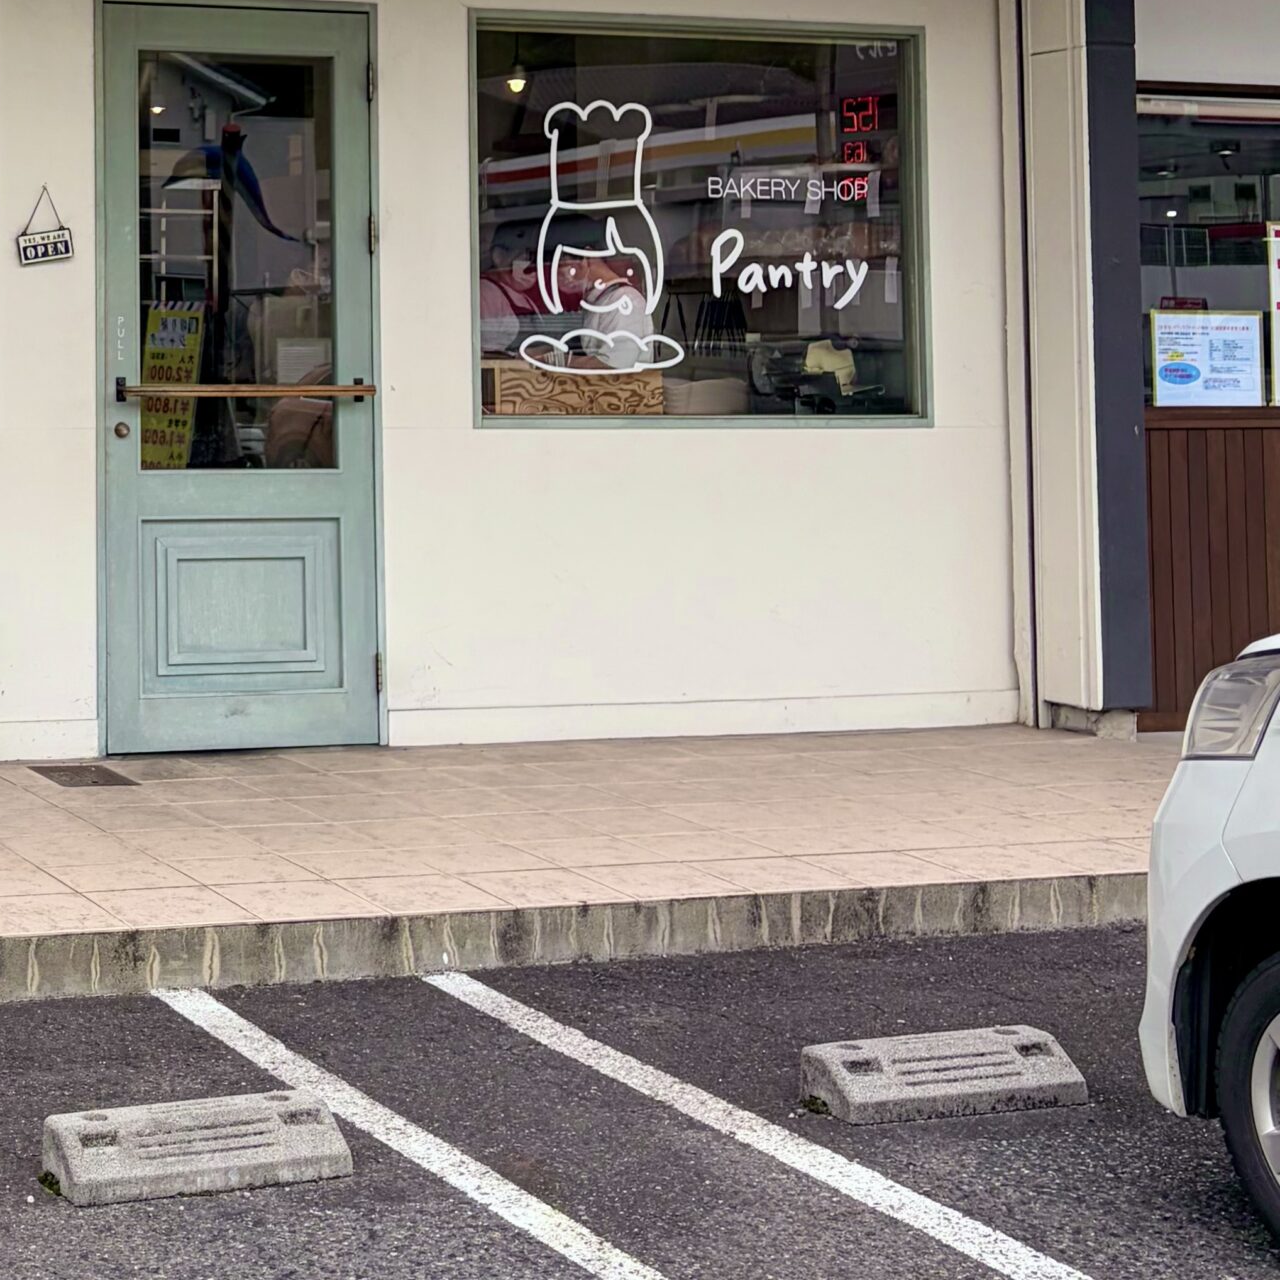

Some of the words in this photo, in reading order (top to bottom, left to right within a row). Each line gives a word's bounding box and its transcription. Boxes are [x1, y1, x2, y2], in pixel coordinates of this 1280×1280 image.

[707, 176, 801, 200] BAKERY
[806, 179, 869, 201] SHOP
[26, 241, 66, 259] OPEN
[710, 228, 869, 310] Pantry
[117, 316, 125, 361] PULL
